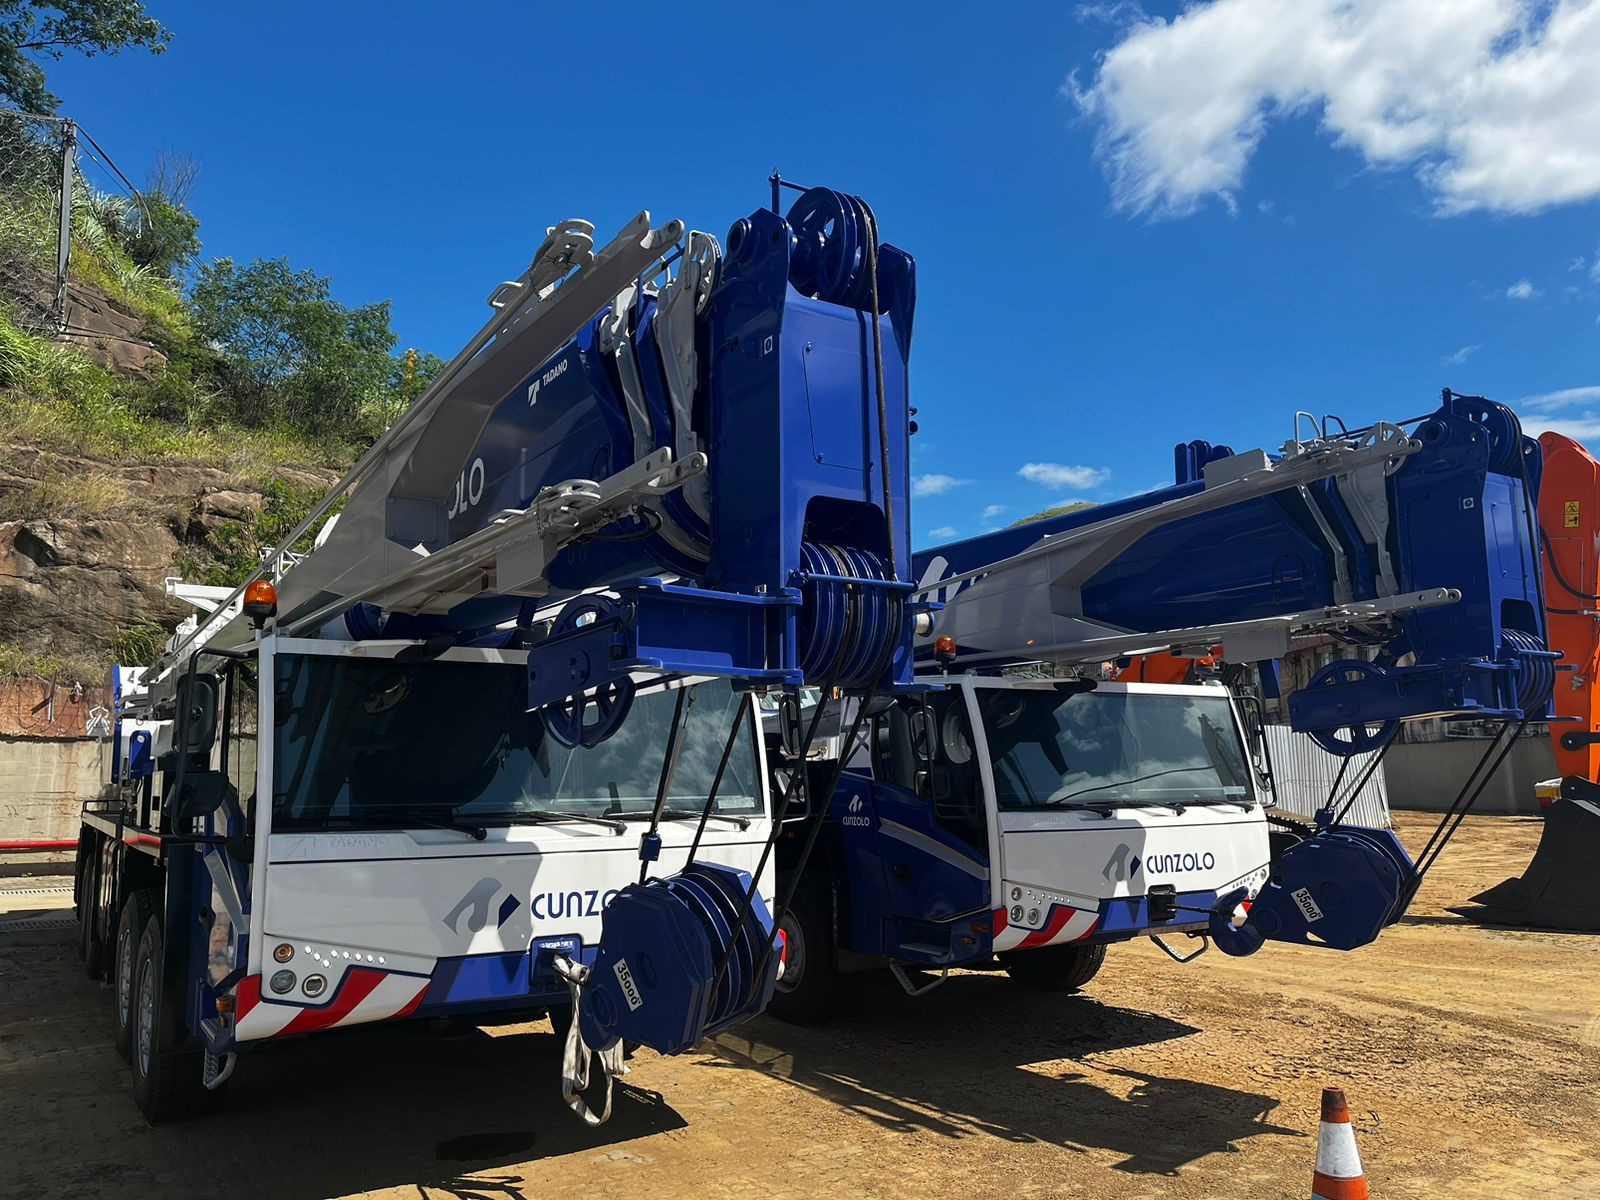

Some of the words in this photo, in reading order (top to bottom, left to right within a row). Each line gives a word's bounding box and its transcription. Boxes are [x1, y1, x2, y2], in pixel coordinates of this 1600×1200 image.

[543, 359, 568, 386] TADANO
[842, 816, 870, 826] CUNZOLO
[1146, 852, 1215, 874] CUNZOLO
